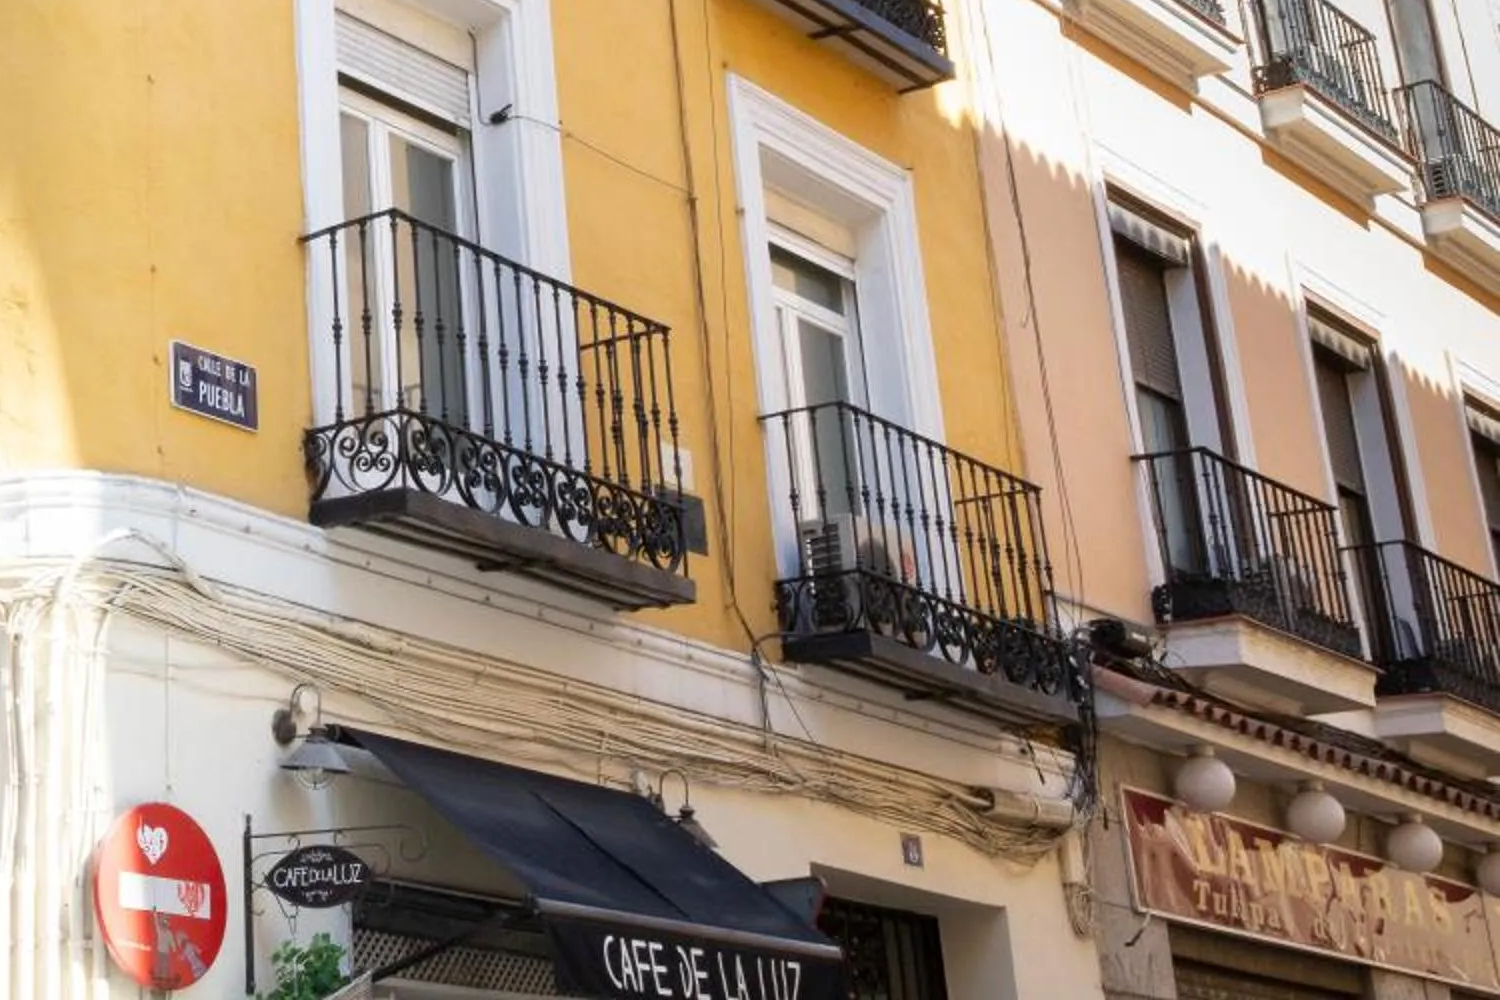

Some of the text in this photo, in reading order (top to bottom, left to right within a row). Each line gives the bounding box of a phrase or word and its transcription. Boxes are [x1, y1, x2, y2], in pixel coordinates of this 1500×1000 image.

[198, 355, 250, 386] CALLE DE LA
[199, 380, 245, 418] PUEBLA
[274, 866, 308, 888] CAFE
[333, 863, 363, 885] LUZ
[1186, 814, 1454, 934] LAMPARAS
[603, 935, 673, 996] CAFE
[676, 945, 712, 1000] DE
[716, 951, 752, 1000] LA
